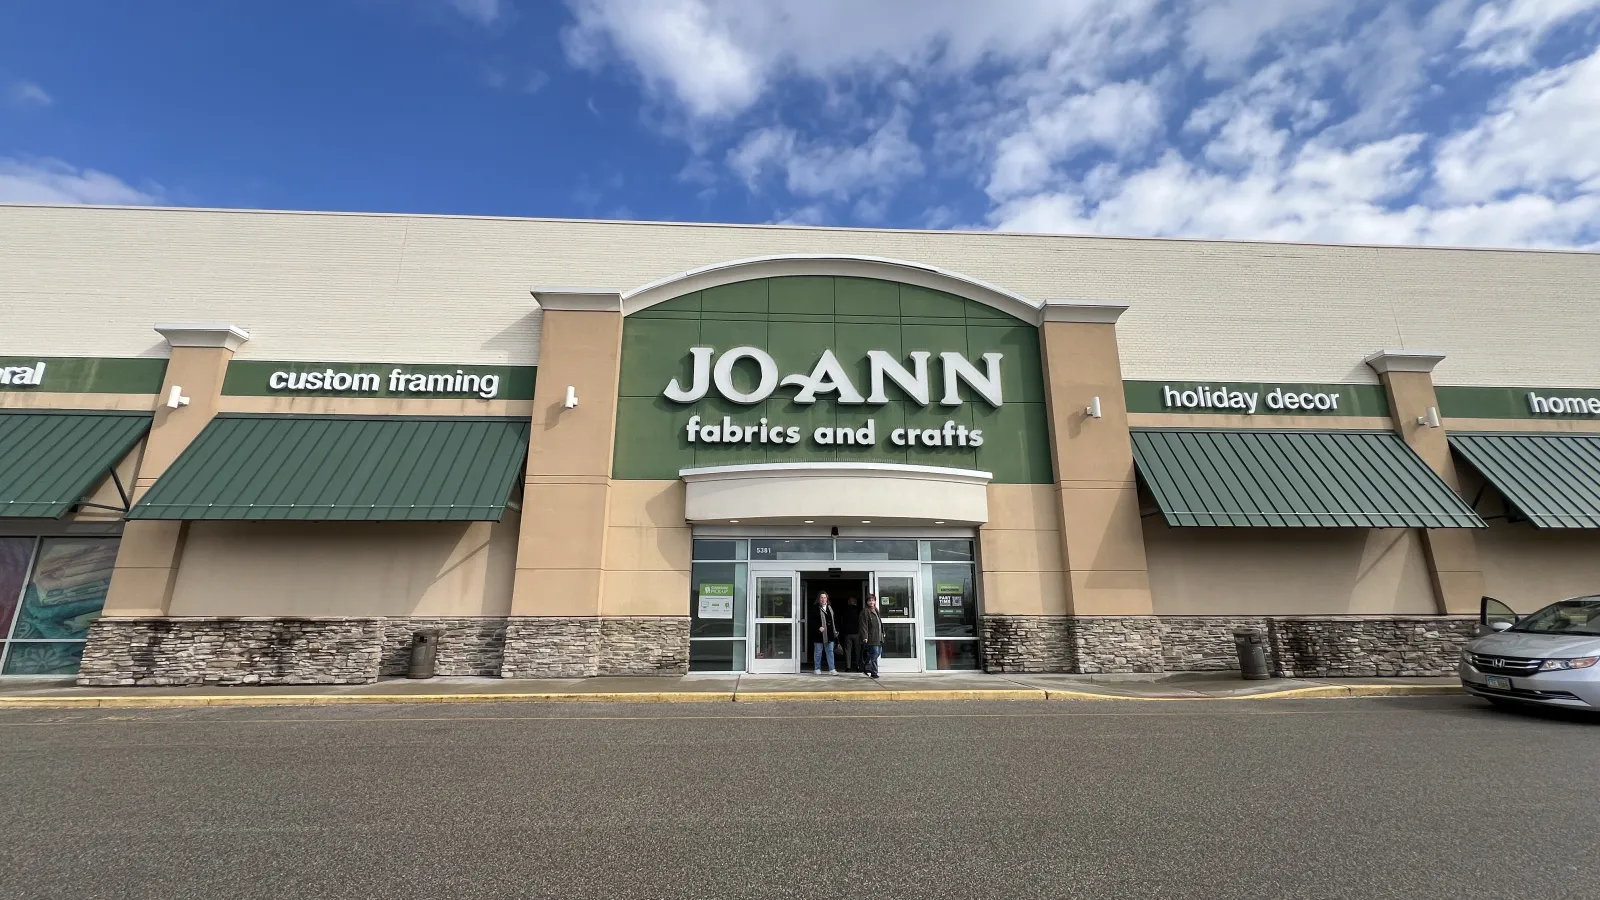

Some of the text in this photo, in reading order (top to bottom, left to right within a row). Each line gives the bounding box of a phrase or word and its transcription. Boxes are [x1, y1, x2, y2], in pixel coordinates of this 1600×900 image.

[0, 361, 46, 385] ral
[269, 367, 500, 399] custom framing
[1163, 385, 1340, 414] holiday decor
[1527, 391, 1600, 415] home
[686, 415, 984, 448] fabrics and crafts
